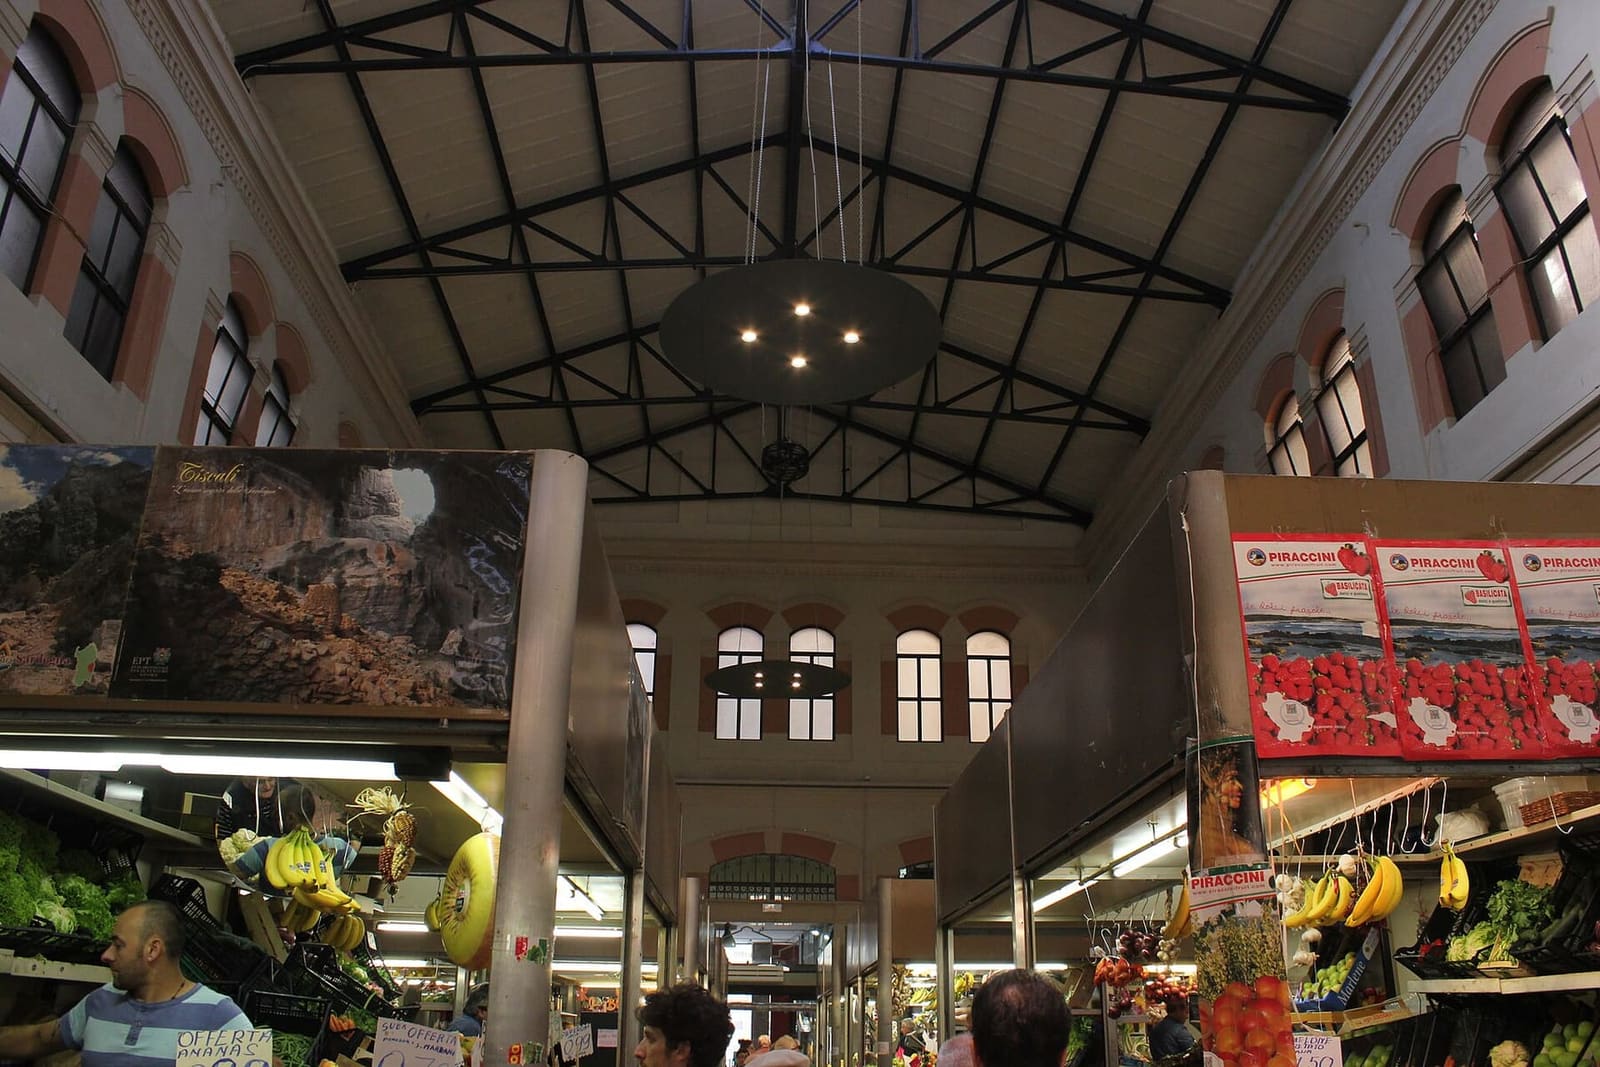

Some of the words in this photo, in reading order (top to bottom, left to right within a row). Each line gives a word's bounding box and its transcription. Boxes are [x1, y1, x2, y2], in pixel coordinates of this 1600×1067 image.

[1269, 552, 1336, 562] PIRACCINI
[1411, 558, 1475, 568] PIRACCINI
[1336, 582, 1368, 591] BASILICATA
[1475, 589, 1508, 598] BASILICATA
[1191, 871, 1265, 890] PIRACCINI
[1337, 960, 1367, 1006] Marlene
[178, 1029, 272, 1047] OFFERTA
[178, 1043, 259, 1058] ANANAS
